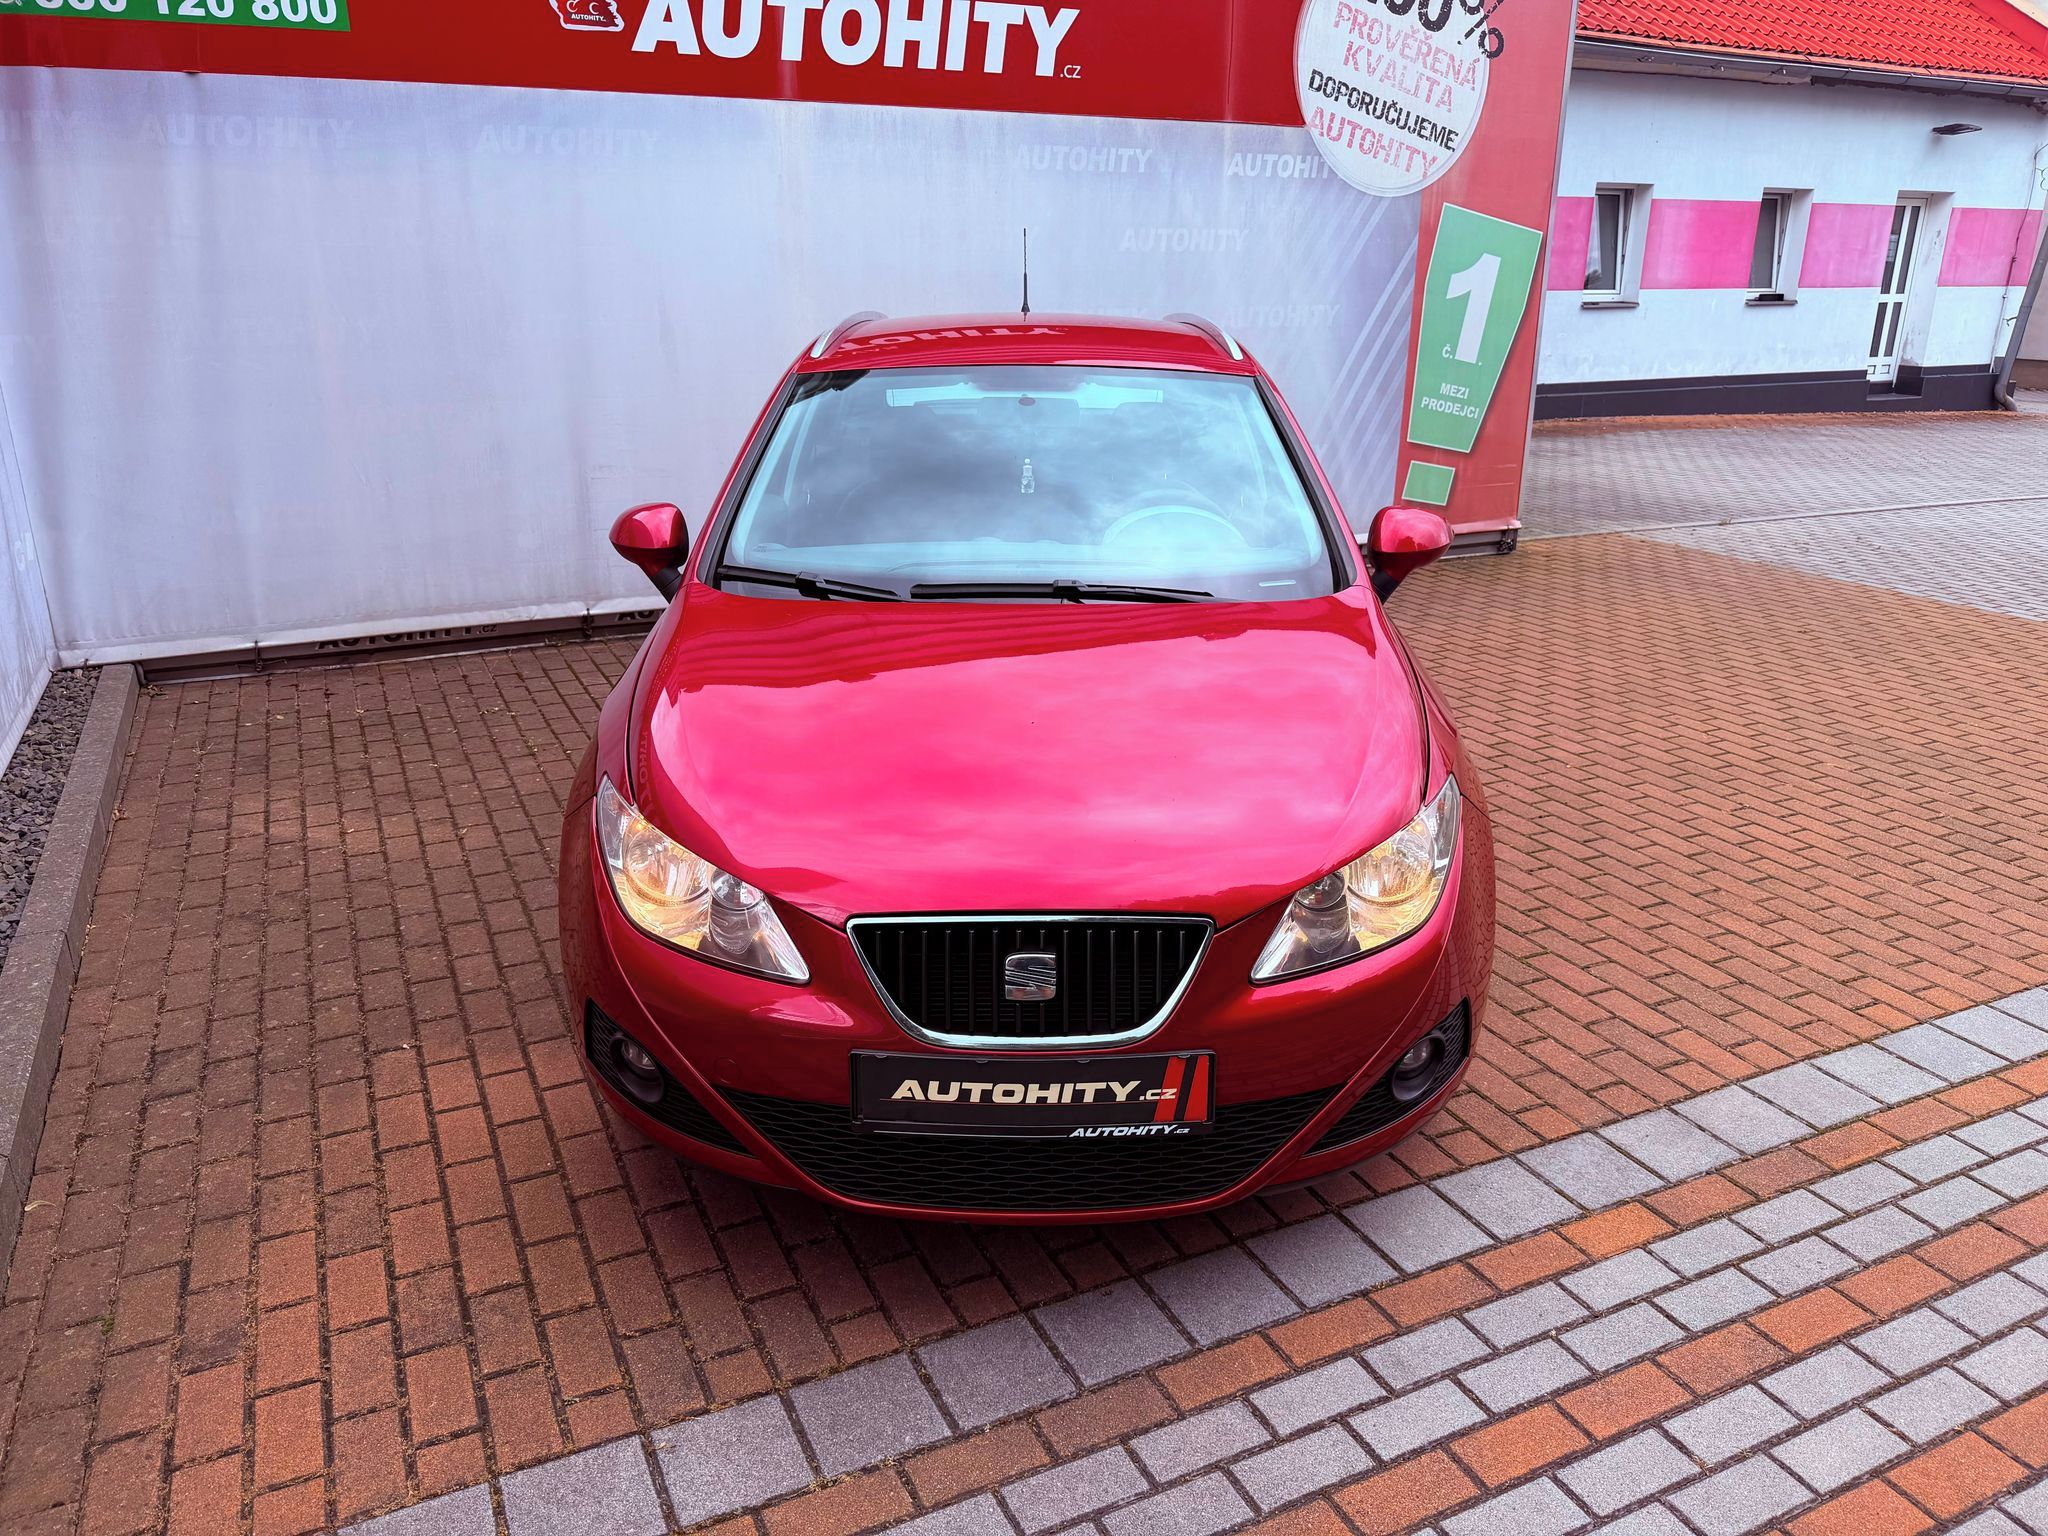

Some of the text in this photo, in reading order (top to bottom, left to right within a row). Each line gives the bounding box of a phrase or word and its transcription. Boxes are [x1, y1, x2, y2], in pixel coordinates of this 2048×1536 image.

[1333, 1, 1481, 91] PROVĚŘENÁ
[1342, 40, 1453, 113] KVALITA
[1308, 69, 1459, 152] DOPORUČUJEME
[1307, 106, 1438, 180] AUTOHITY
[1014, 145, 1152, 174] AUTOHITY
[1226, 152, 1342, 179] AUTOHIT
[1119, 227, 1249, 252] AUTOHITY
[1439, 383, 1470, 400] MEZI
[1420, 397, 1480, 419] PRODEJCI
